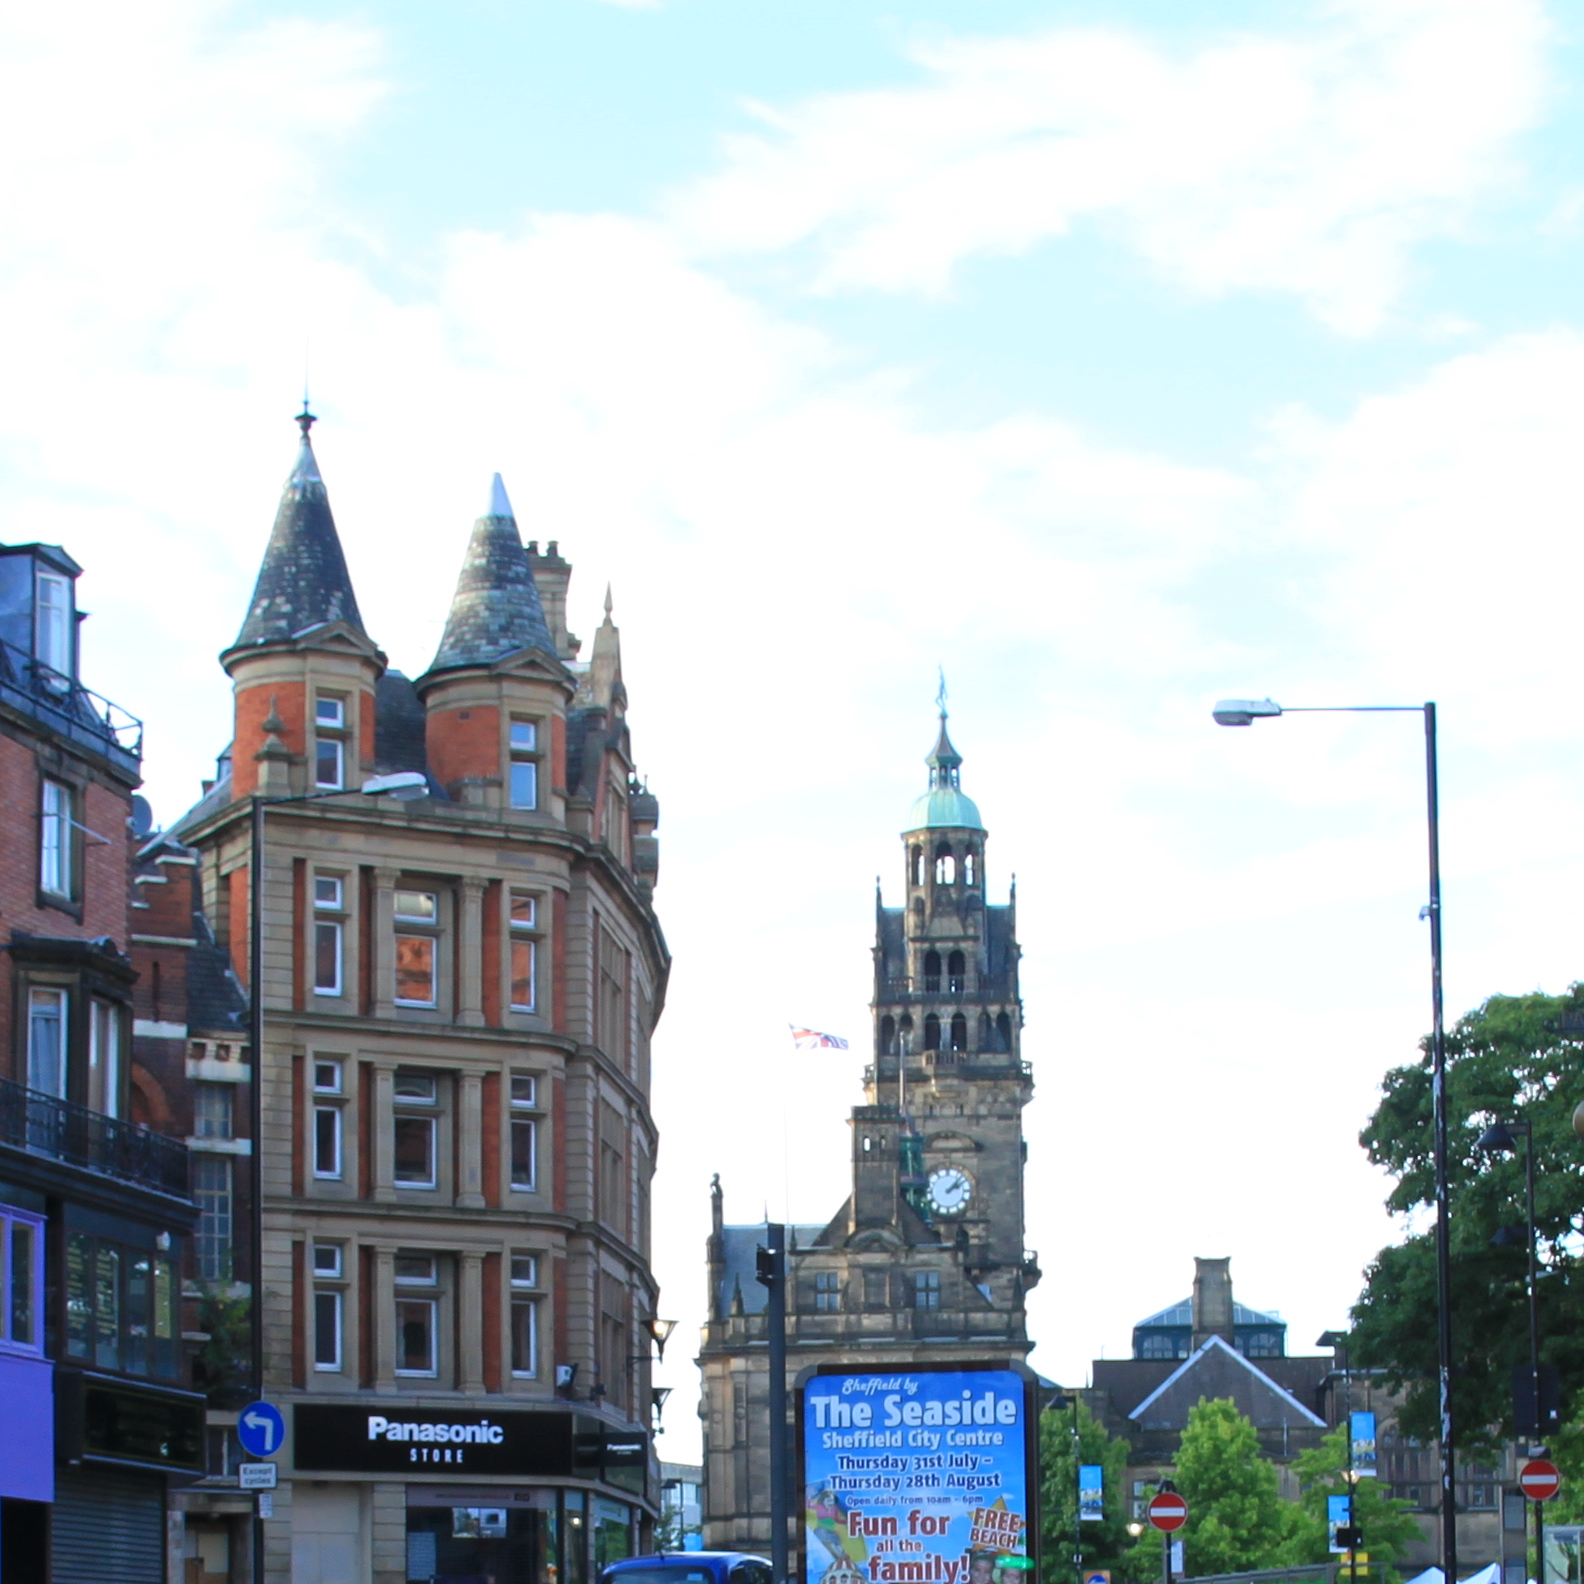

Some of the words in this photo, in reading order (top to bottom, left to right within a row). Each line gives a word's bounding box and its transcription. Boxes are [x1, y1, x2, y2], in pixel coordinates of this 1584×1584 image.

[842, 1378, 902, 1396] Sheffield
[904, 1377, 919, 1396] by
[810, 1395, 873, 1429] The
[883, 1389, 1017, 1427] Seaside
[368, 1415, 504, 1444] Panasonic
[822, 1430, 903, 1449] Sheffield
[908, 1429, 942, 1451] City
[946, 1429, 1004, 1447] Centre
[410, 1448, 464, 1464] STORE
[837, 1454, 909, 1472] Thursday
[914, 1455, 943, 1470] 31st
[947, 1453, 979, 1471] July
[830, 1474, 901, 1491] Thursday
[906, 1473, 941, 1488] 28th
[946, 1472, 1001, 1491] August
[846, 1496, 872, 1507] Open
[874, 1495, 898, 1506] daily
[900, 1494, 923, 1505] from
[962, 1494, 984, 1506] 6pm
[848, 1510, 898, 1537] Fun
[907, 1508, 951, 1536] for
[972, 1506, 1023, 1533] FREE
[876, 1539, 894, 1553] all
[899, 1538, 923, 1553] the
[969, 1527, 1019, 1549] BEACH
